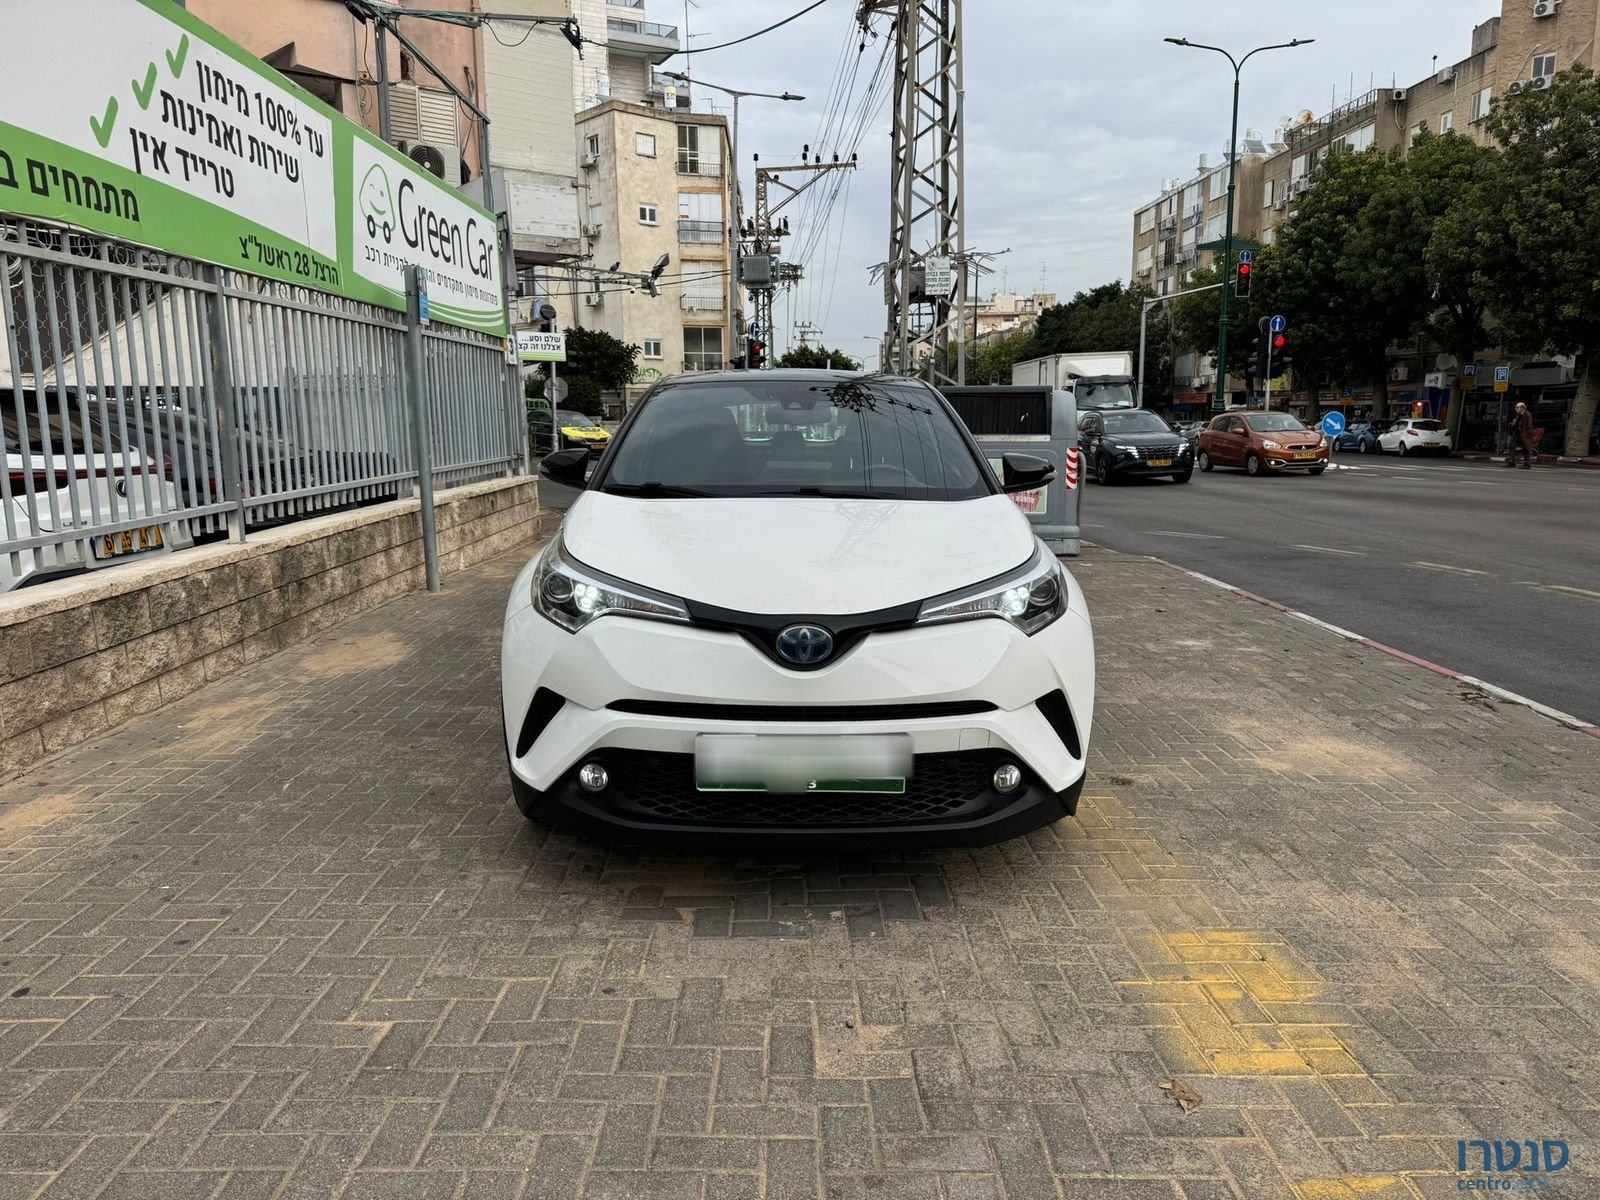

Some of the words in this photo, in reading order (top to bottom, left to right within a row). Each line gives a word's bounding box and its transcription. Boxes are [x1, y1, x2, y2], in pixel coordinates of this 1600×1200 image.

[196, 59, 250, 117] מימון
[160, 90, 243, 157] ואמינות
[255, 92, 302, 146] 100%
[304, 125, 324, 158] עד
[129, 128, 171, 175] אין
[175, 146, 234, 198] טרייד
[248, 134, 299, 183] שירות
[26, 158, 140, 222] מתמחים
[398, 178, 464, 269] Green
[466, 217, 493, 281] Car
[294, 251, 309, 276] 28
[312, 260, 339, 286] הרצל
[364, 245, 381, 264] רכב
[437, 273, 464, 294] מתקדמים
[541, 342, 562, 351] אצלנו
[544, 335, 561, 343] שלם
